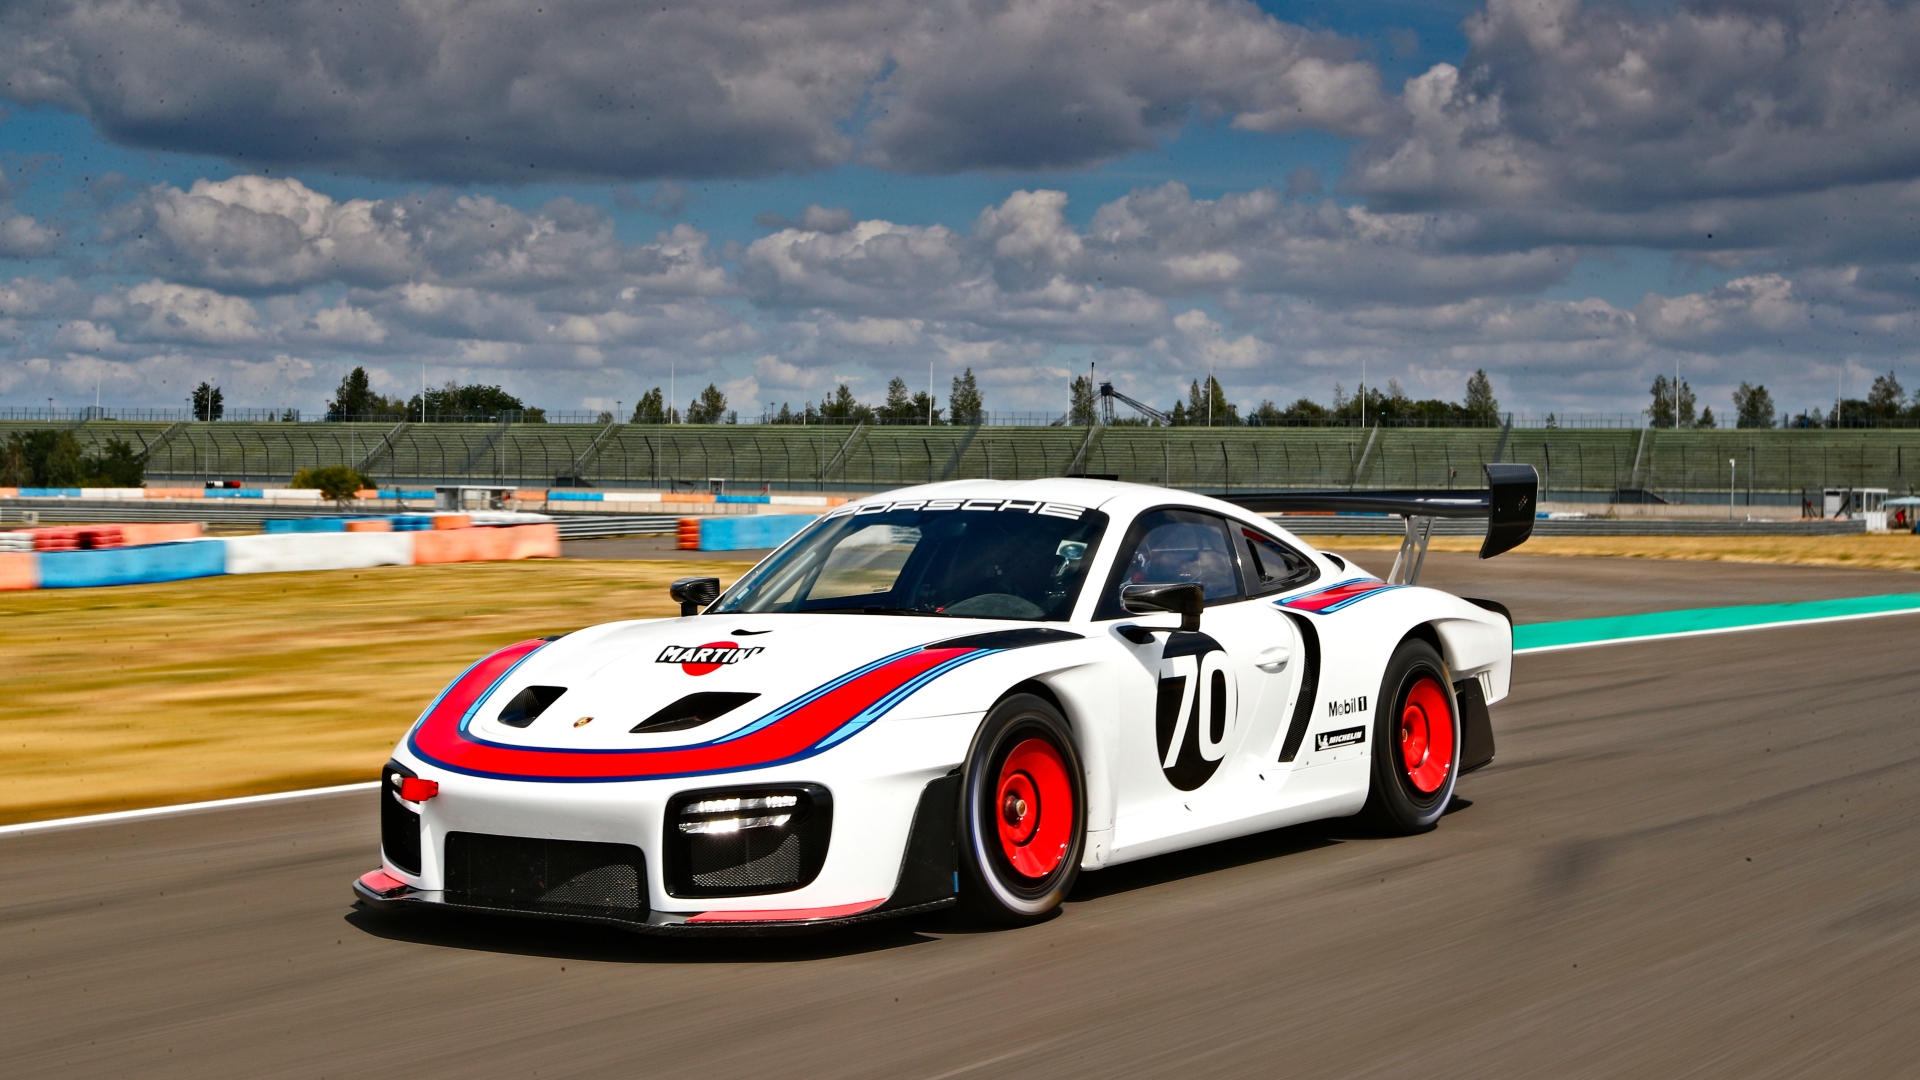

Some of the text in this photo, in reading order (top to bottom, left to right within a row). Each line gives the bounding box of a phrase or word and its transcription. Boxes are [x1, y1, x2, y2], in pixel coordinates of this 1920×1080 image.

[823, 498, 1087, 522] PORSCHE
[1160, 649, 1236, 769] 70
[1328, 697, 1357, 718] Mobil
[1328, 730, 1363, 745] MICHELIN
